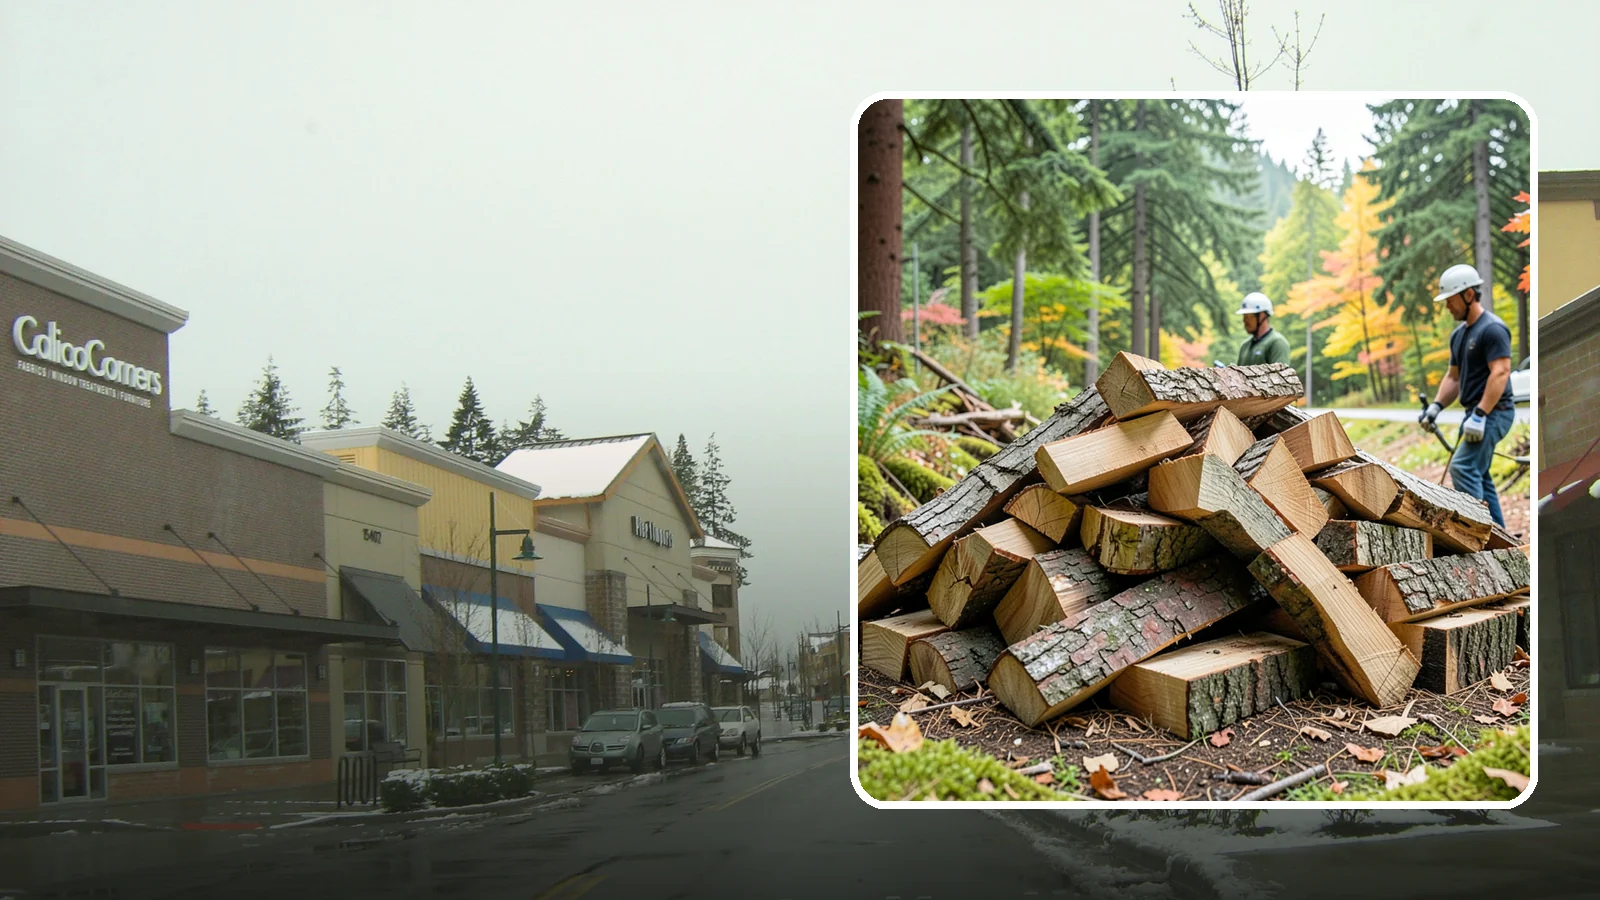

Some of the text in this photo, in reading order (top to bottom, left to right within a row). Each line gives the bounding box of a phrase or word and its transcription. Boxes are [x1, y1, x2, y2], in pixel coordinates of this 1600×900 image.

[17, 360, 151, 408] FABRICS WINDOW TREATMENTS FURNITURE
